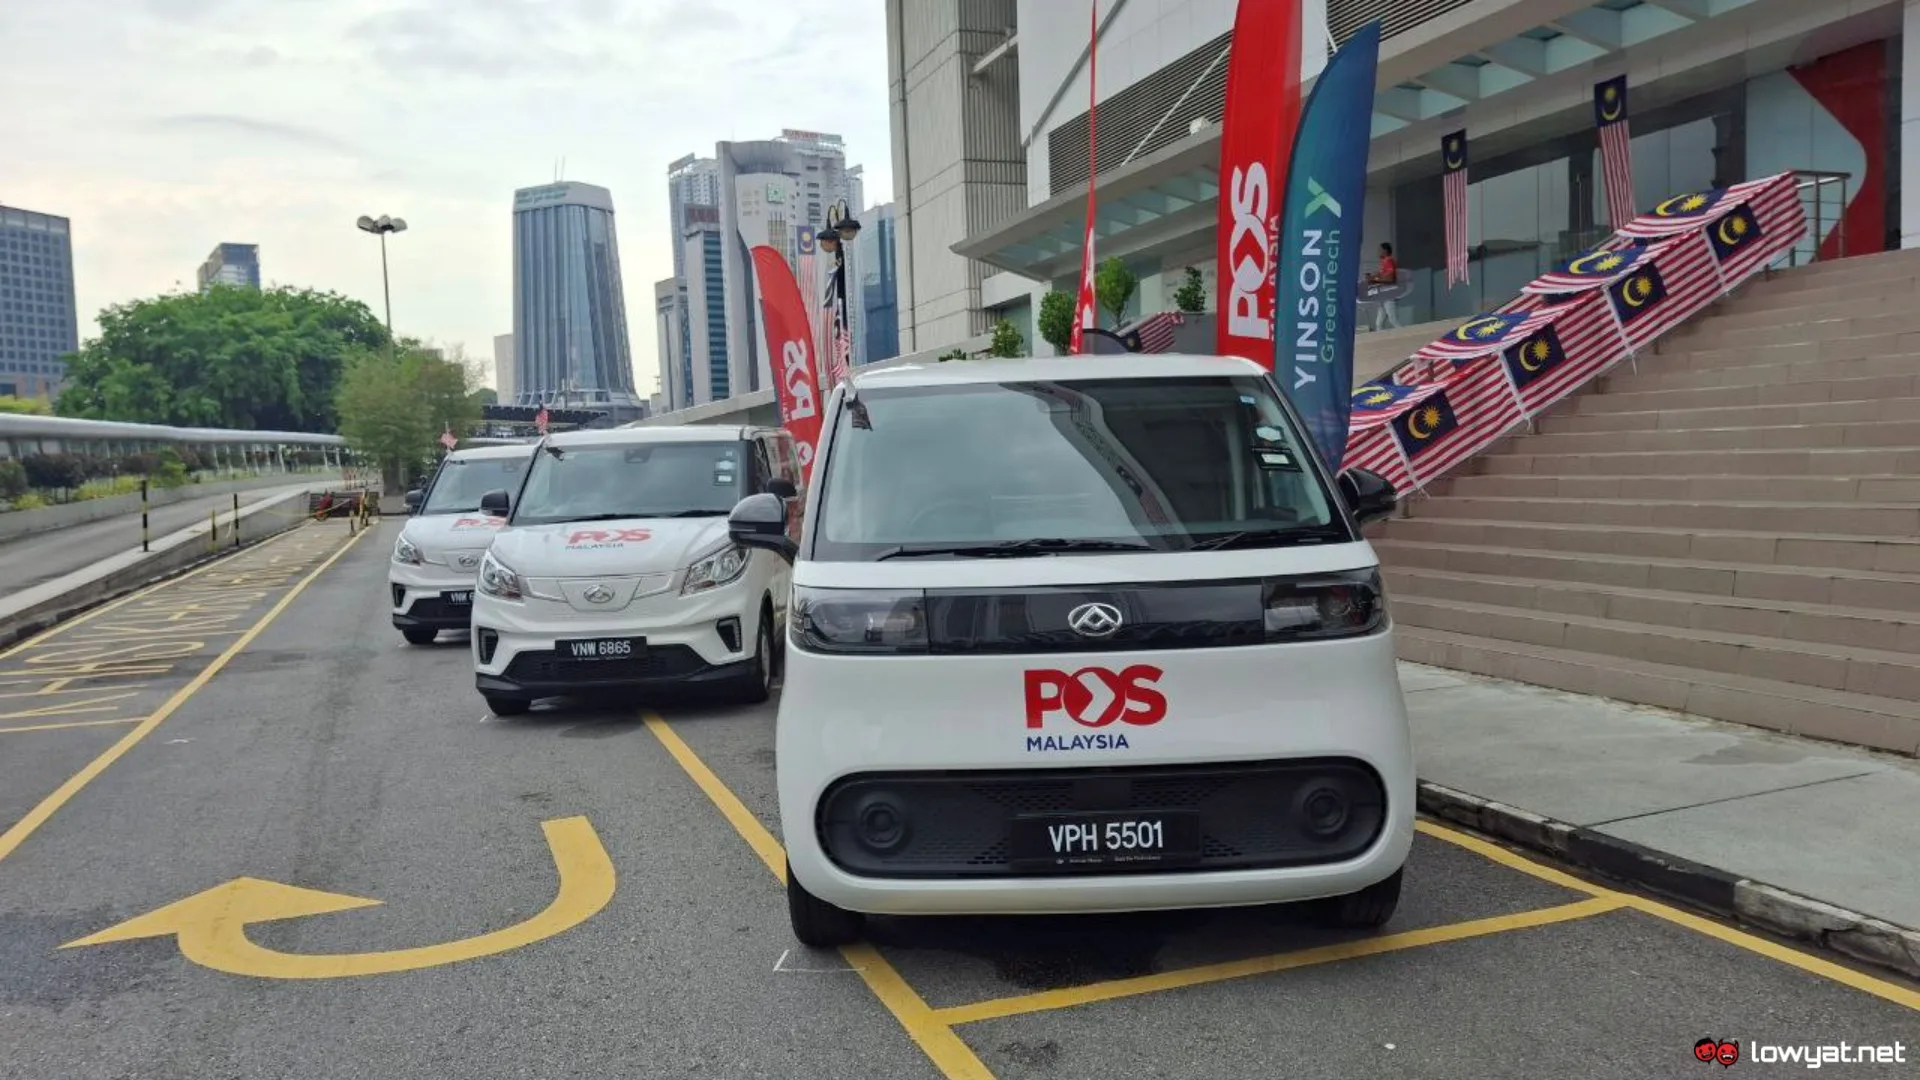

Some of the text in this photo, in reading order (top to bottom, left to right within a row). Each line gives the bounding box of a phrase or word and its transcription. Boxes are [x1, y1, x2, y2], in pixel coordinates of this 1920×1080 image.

[1228, 162, 1269, 340] POS
[1294, 230, 1322, 390] YINSON
[1321, 230, 1340, 363] GreenTech
[571, 640, 631, 656] VNW 6865
[1024, 664, 1167, 729] POS
[1026, 734, 1129, 752] MALAYSIA
[1048, 820, 1164, 853] VPH 5501
